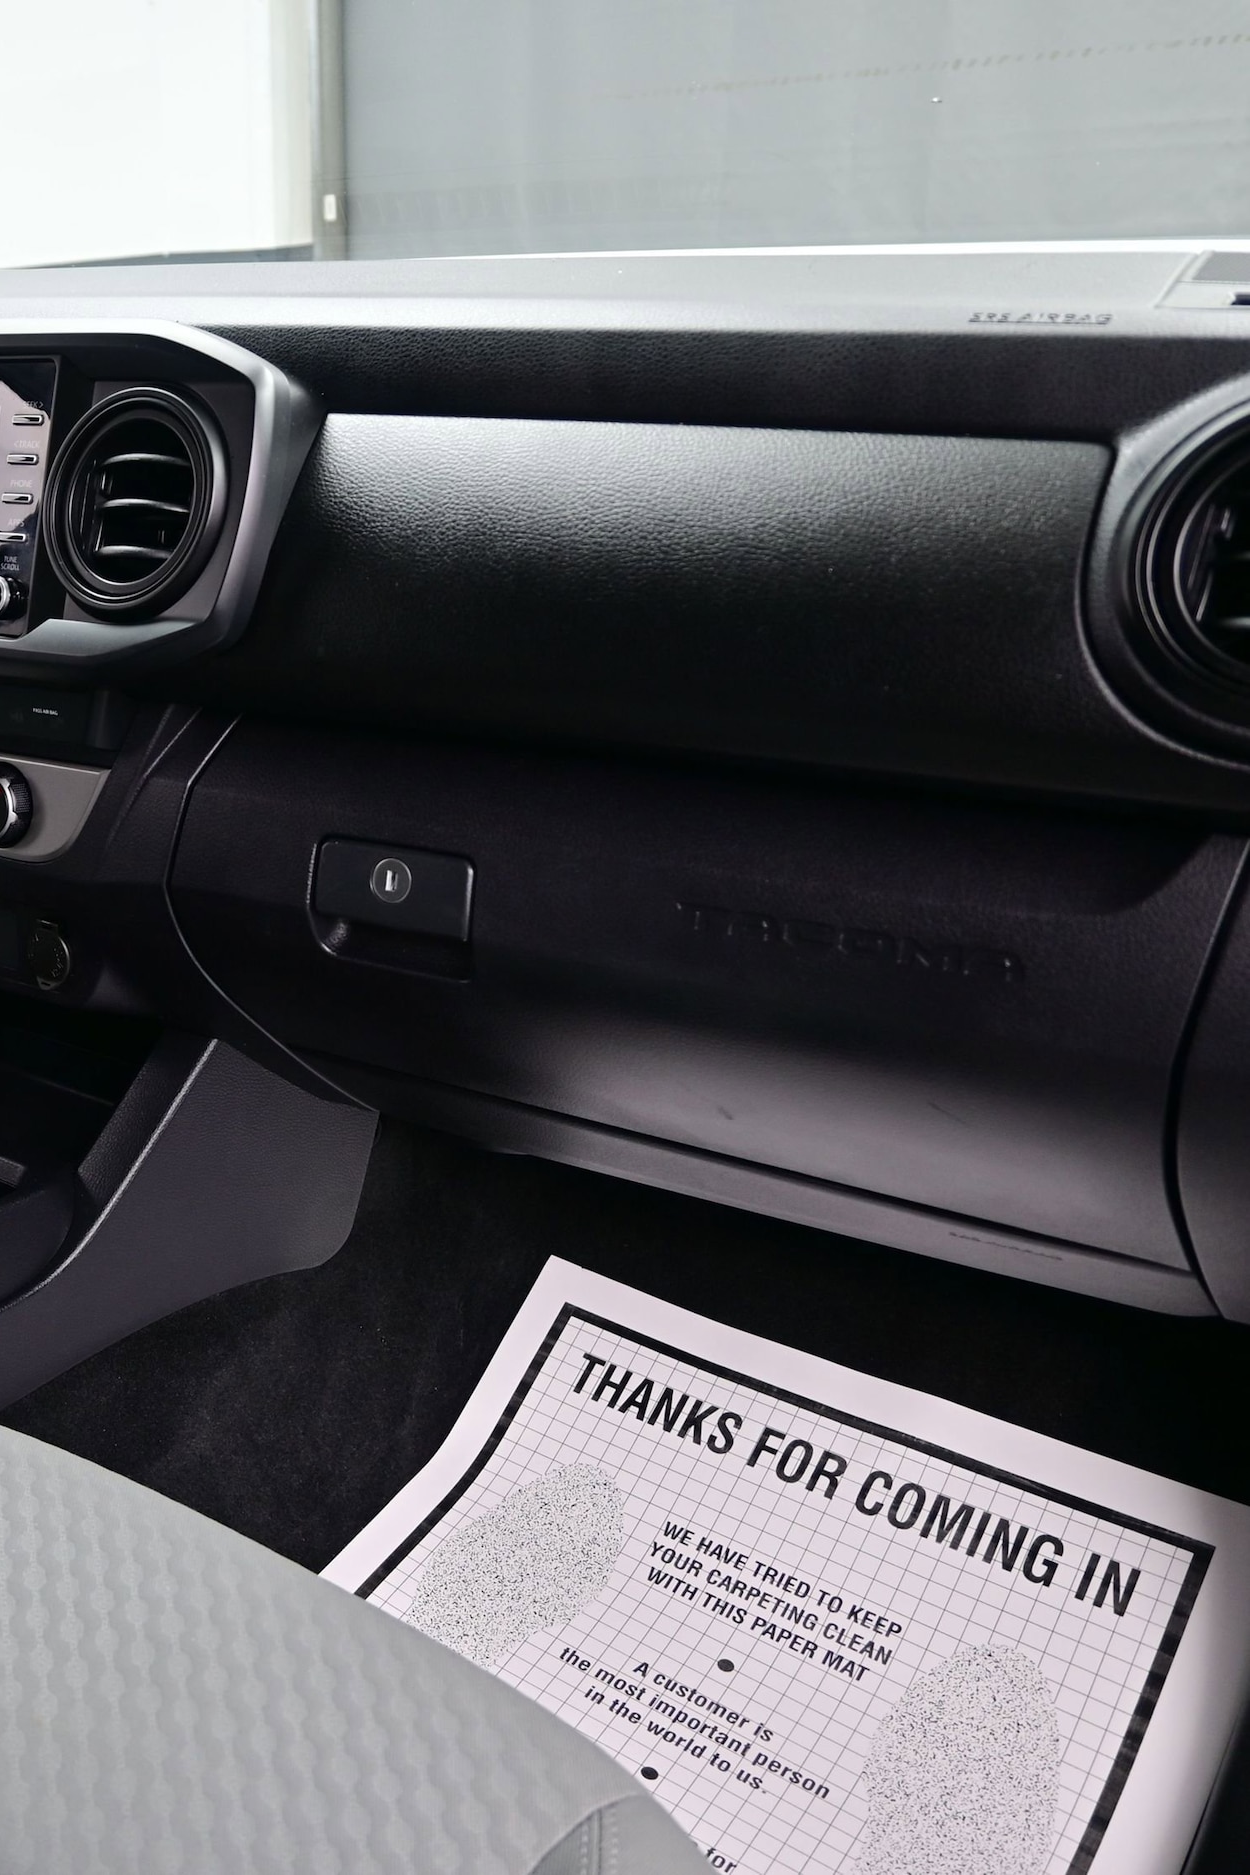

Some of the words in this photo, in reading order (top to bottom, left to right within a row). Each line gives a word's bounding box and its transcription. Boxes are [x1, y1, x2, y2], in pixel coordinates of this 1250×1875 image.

[969, 311, 1010, 323] SRS
[1016, 312, 1113, 325] AIRBAG
[10, 479, 32, 488] PHONE
[573, 1352, 743, 1454] THANKS
[746, 1426, 848, 1500] FOR
[854, 1470, 1064, 1587] COMING
[1074, 1553, 1141, 1617] IN
[647, 1566, 699, 1601] WITH
[701, 1592, 748, 1625] THIS
[750, 1616, 818, 1659] PAPER
[822, 1650, 871, 1682] MAT
[649, 1541, 703, 1577] YOUR
[706, 1569, 818, 1631] CARPETING
[823, 1623, 892, 1665] CLEAN
[663, 1521, 695, 1547] WE
[696, 1537, 749, 1571] HAVE
[752, 1561, 811, 1599] TRIED
[812, 1589, 843, 1614] TO
[847, 1605, 902, 1638] KEEP
[559, 1647, 591, 1672] the
[594, 1668, 647, 1702] most
[648, 1694, 751, 1757] important
[751, 1751, 830, 1799] person
[584, 1685, 606, 1705] in
[608, 1699, 642, 1725] the
[646, 1720, 707, 1759] world
[709, 1752, 732, 1773] to
[735, 1768, 768, 1794] us.
[633, 1661, 650, 1678] A
[653, 1672, 750, 1729] customer
[753, 1722, 774, 1742] is
[706, 1847, 737, 1873] for
